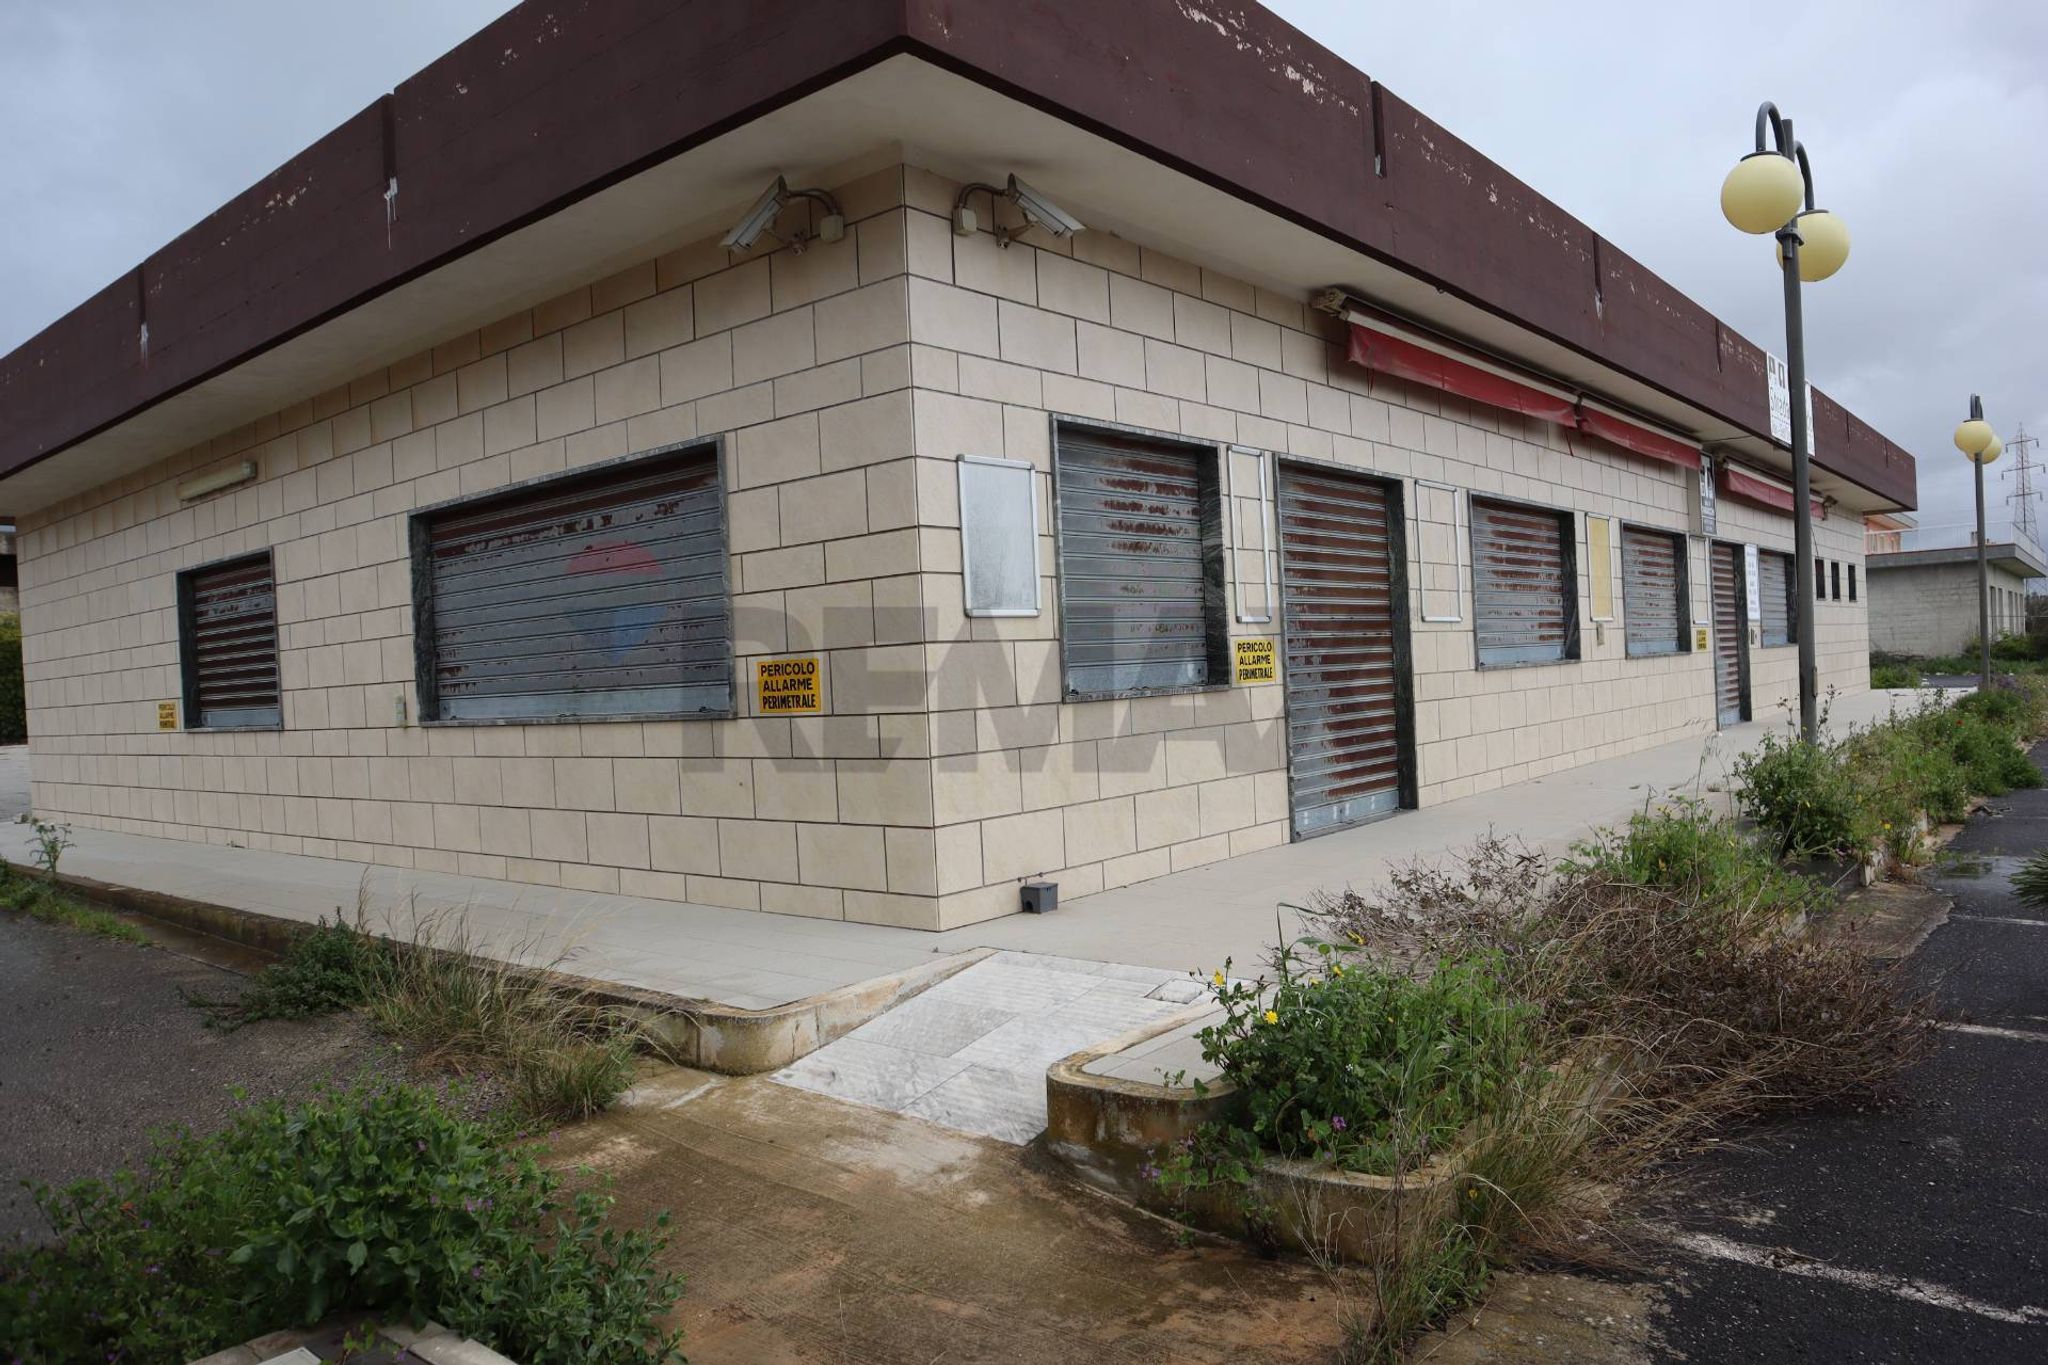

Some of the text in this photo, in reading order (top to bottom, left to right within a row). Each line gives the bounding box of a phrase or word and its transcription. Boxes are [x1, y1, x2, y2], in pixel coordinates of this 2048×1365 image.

[1237, 642, 1272, 653] PERICOLO
[1239, 654, 1271, 666] ALLARME
[760, 661, 815, 677] PERICOLO
[1239, 667, 1273, 680] PERIMETRALE
[762, 678, 814, 693] ALLARME
[762, 694, 816, 709] PERIMETRALE
